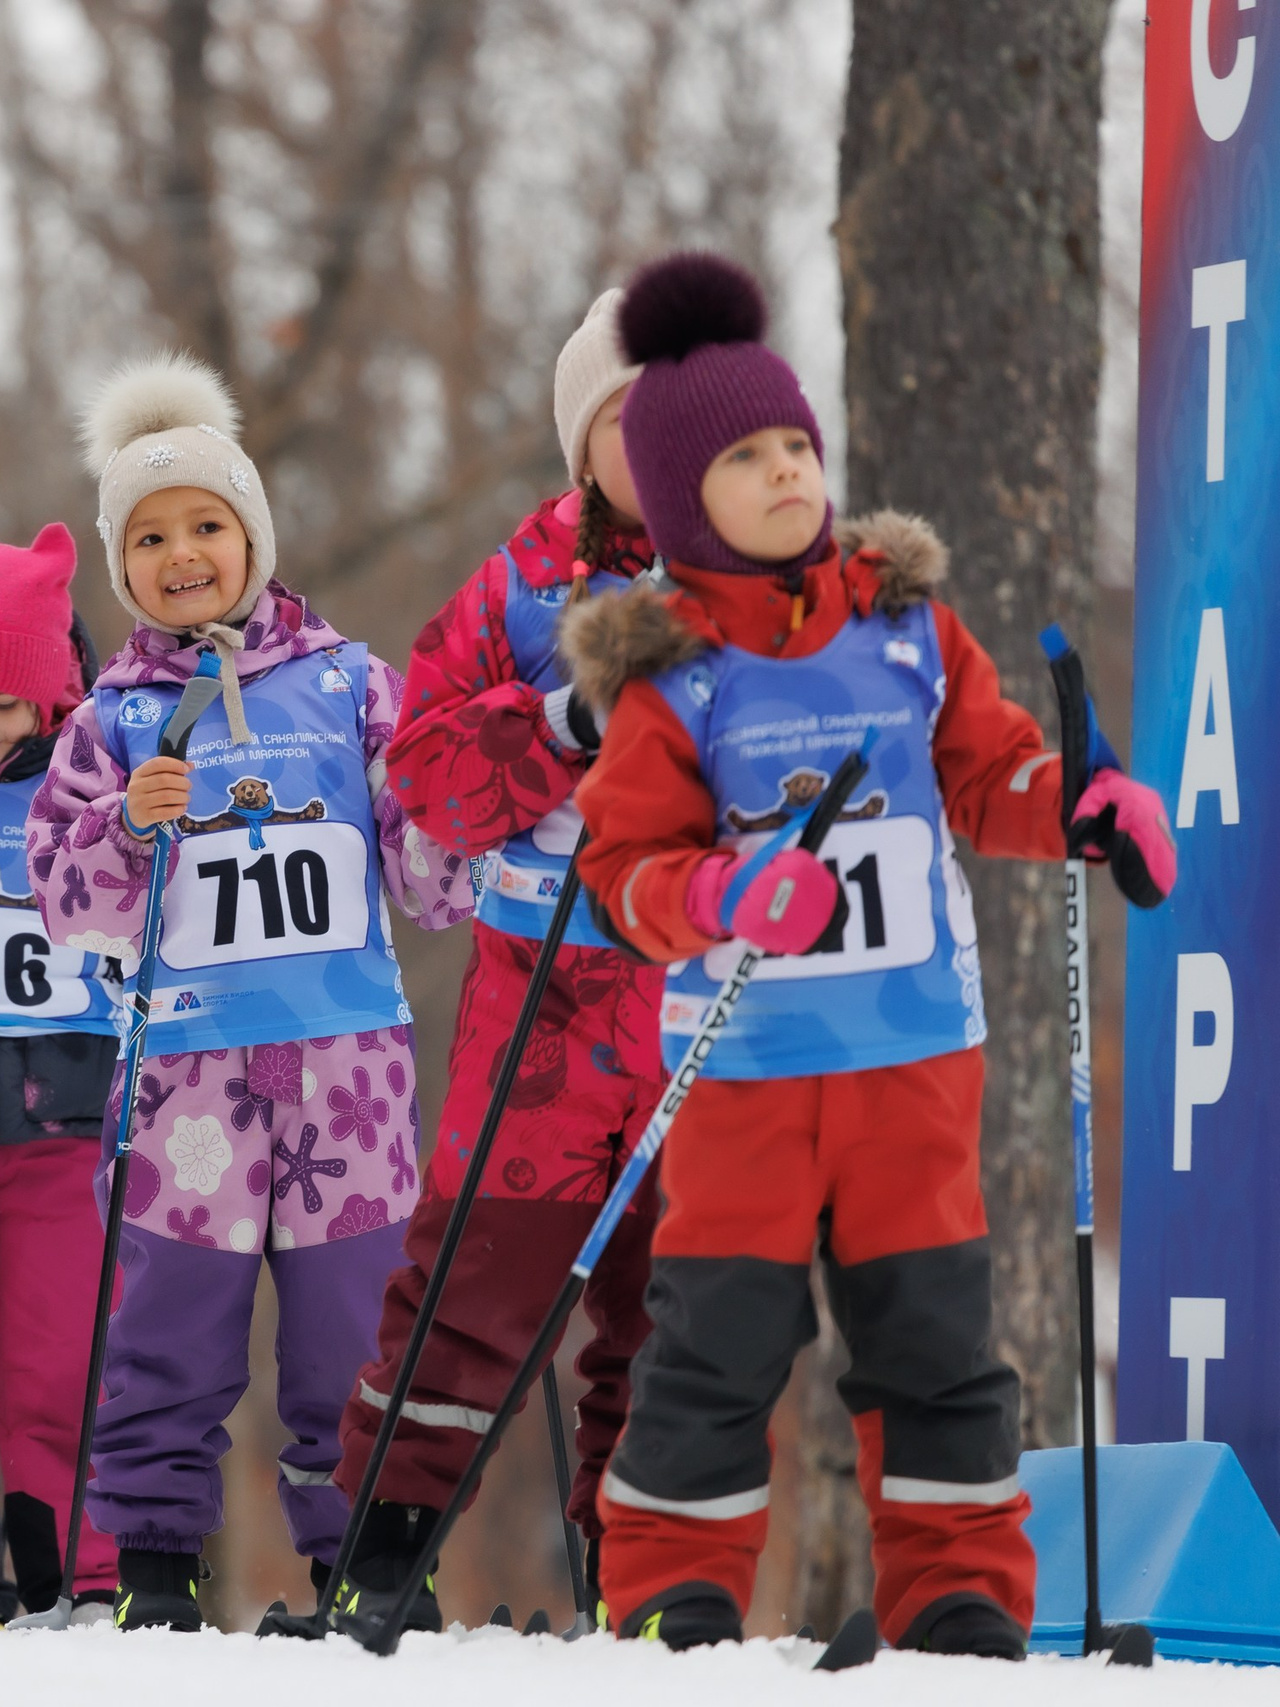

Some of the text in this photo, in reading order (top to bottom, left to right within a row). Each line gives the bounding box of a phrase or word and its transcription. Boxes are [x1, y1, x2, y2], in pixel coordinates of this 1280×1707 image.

[249, 747, 310, 760] МАРАФОН
[263, 731, 347, 745] САХАЛИНСКИЙ
[197, 849, 330, 946] 710
[662, 952, 759, 1116] BRADOS
